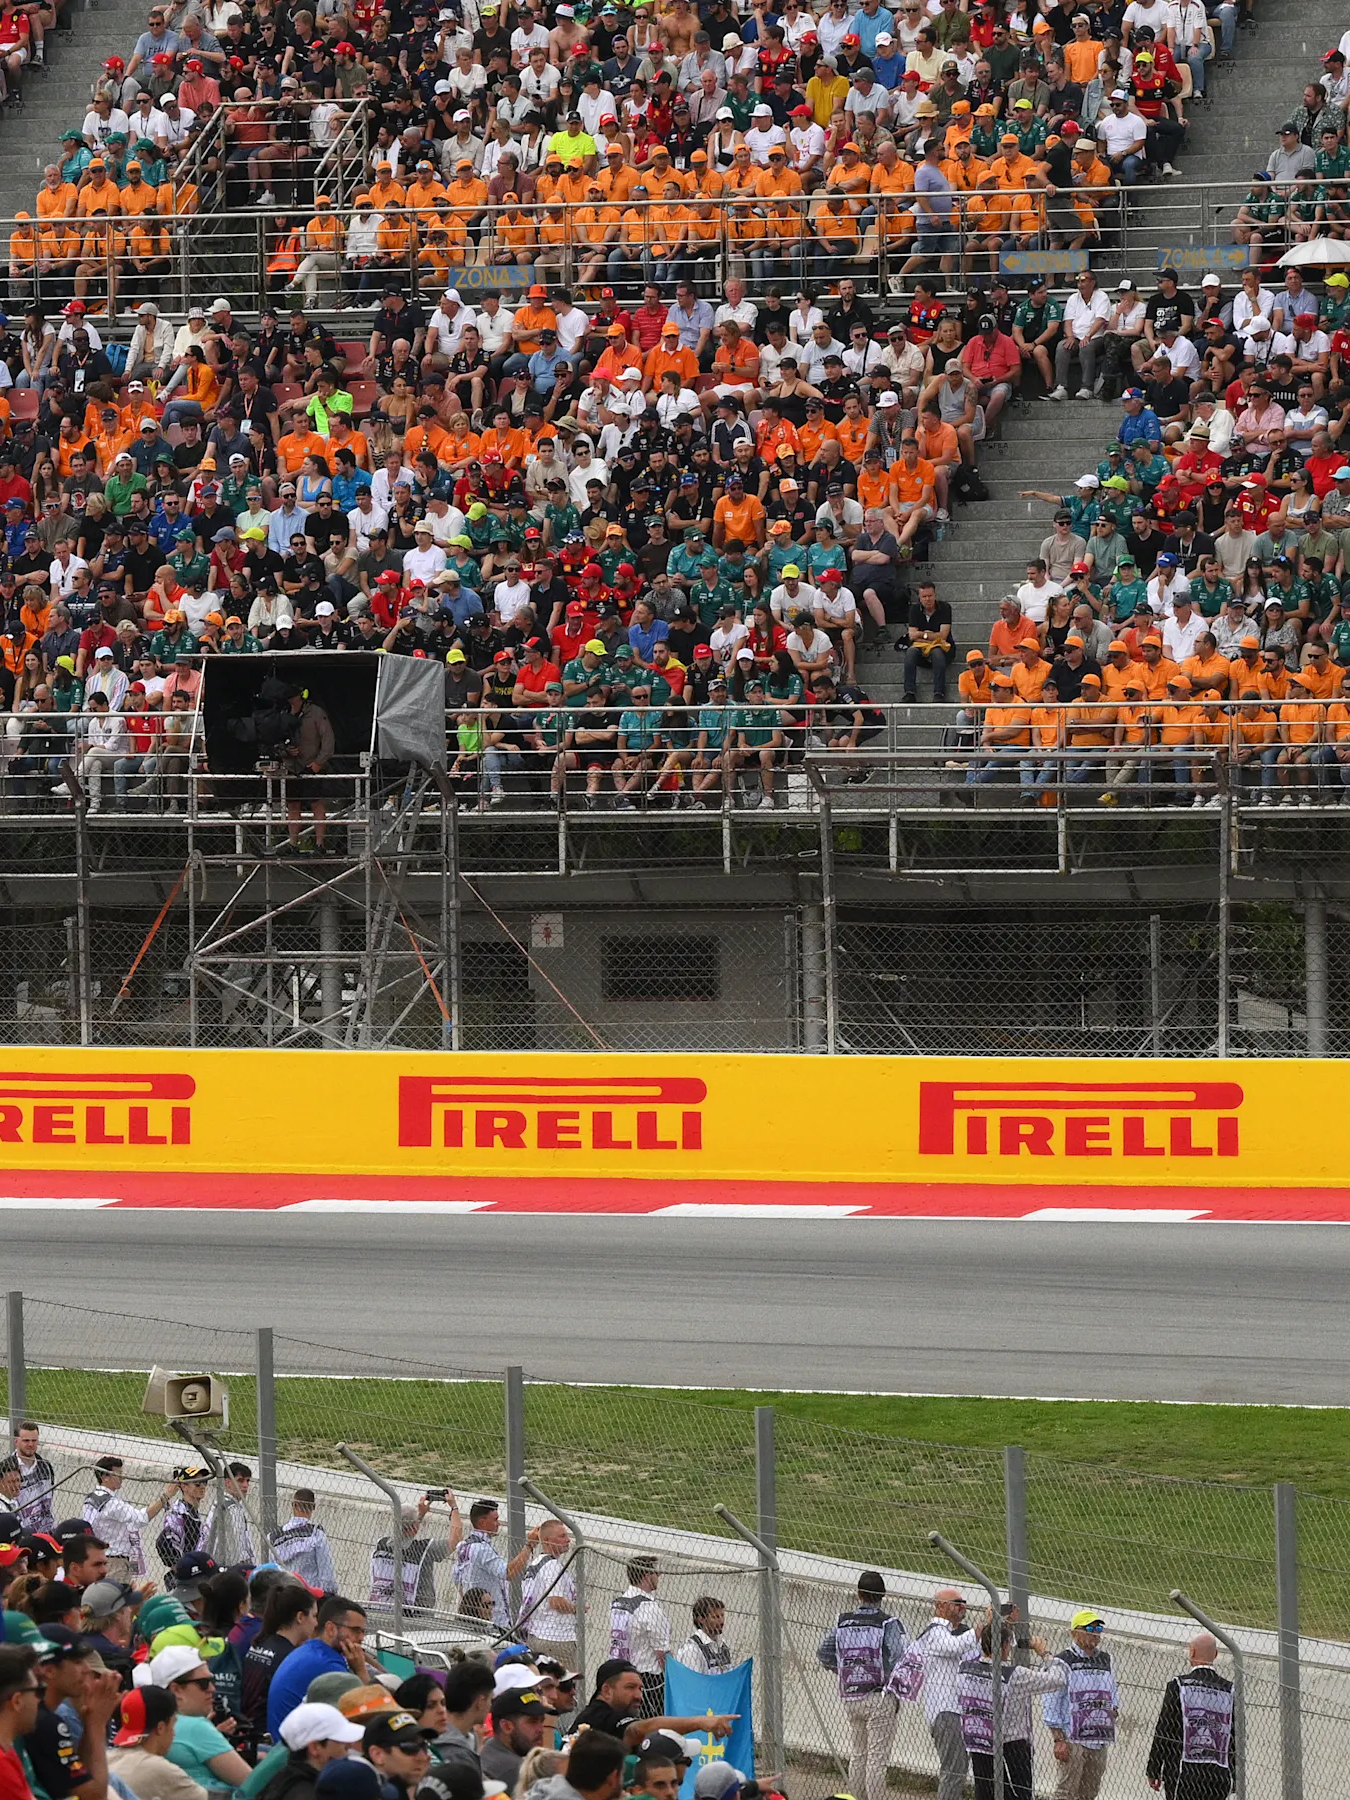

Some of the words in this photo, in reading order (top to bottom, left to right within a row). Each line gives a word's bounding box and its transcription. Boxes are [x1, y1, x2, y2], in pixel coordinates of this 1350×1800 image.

[1024, 251, 1072, 271] ZONA
[1077, 250, 1086, 271] 3
[1161, 247, 1208, 268] ZONA
[1213, 247, 1222, 265] 4
[454, 266, 511, 287] ZONA
[517, 265, 530, 285] 3
[399, 1077, 707, 1150] PIRELLI
[919, 1082, 1244, 1157] PIRELLI
